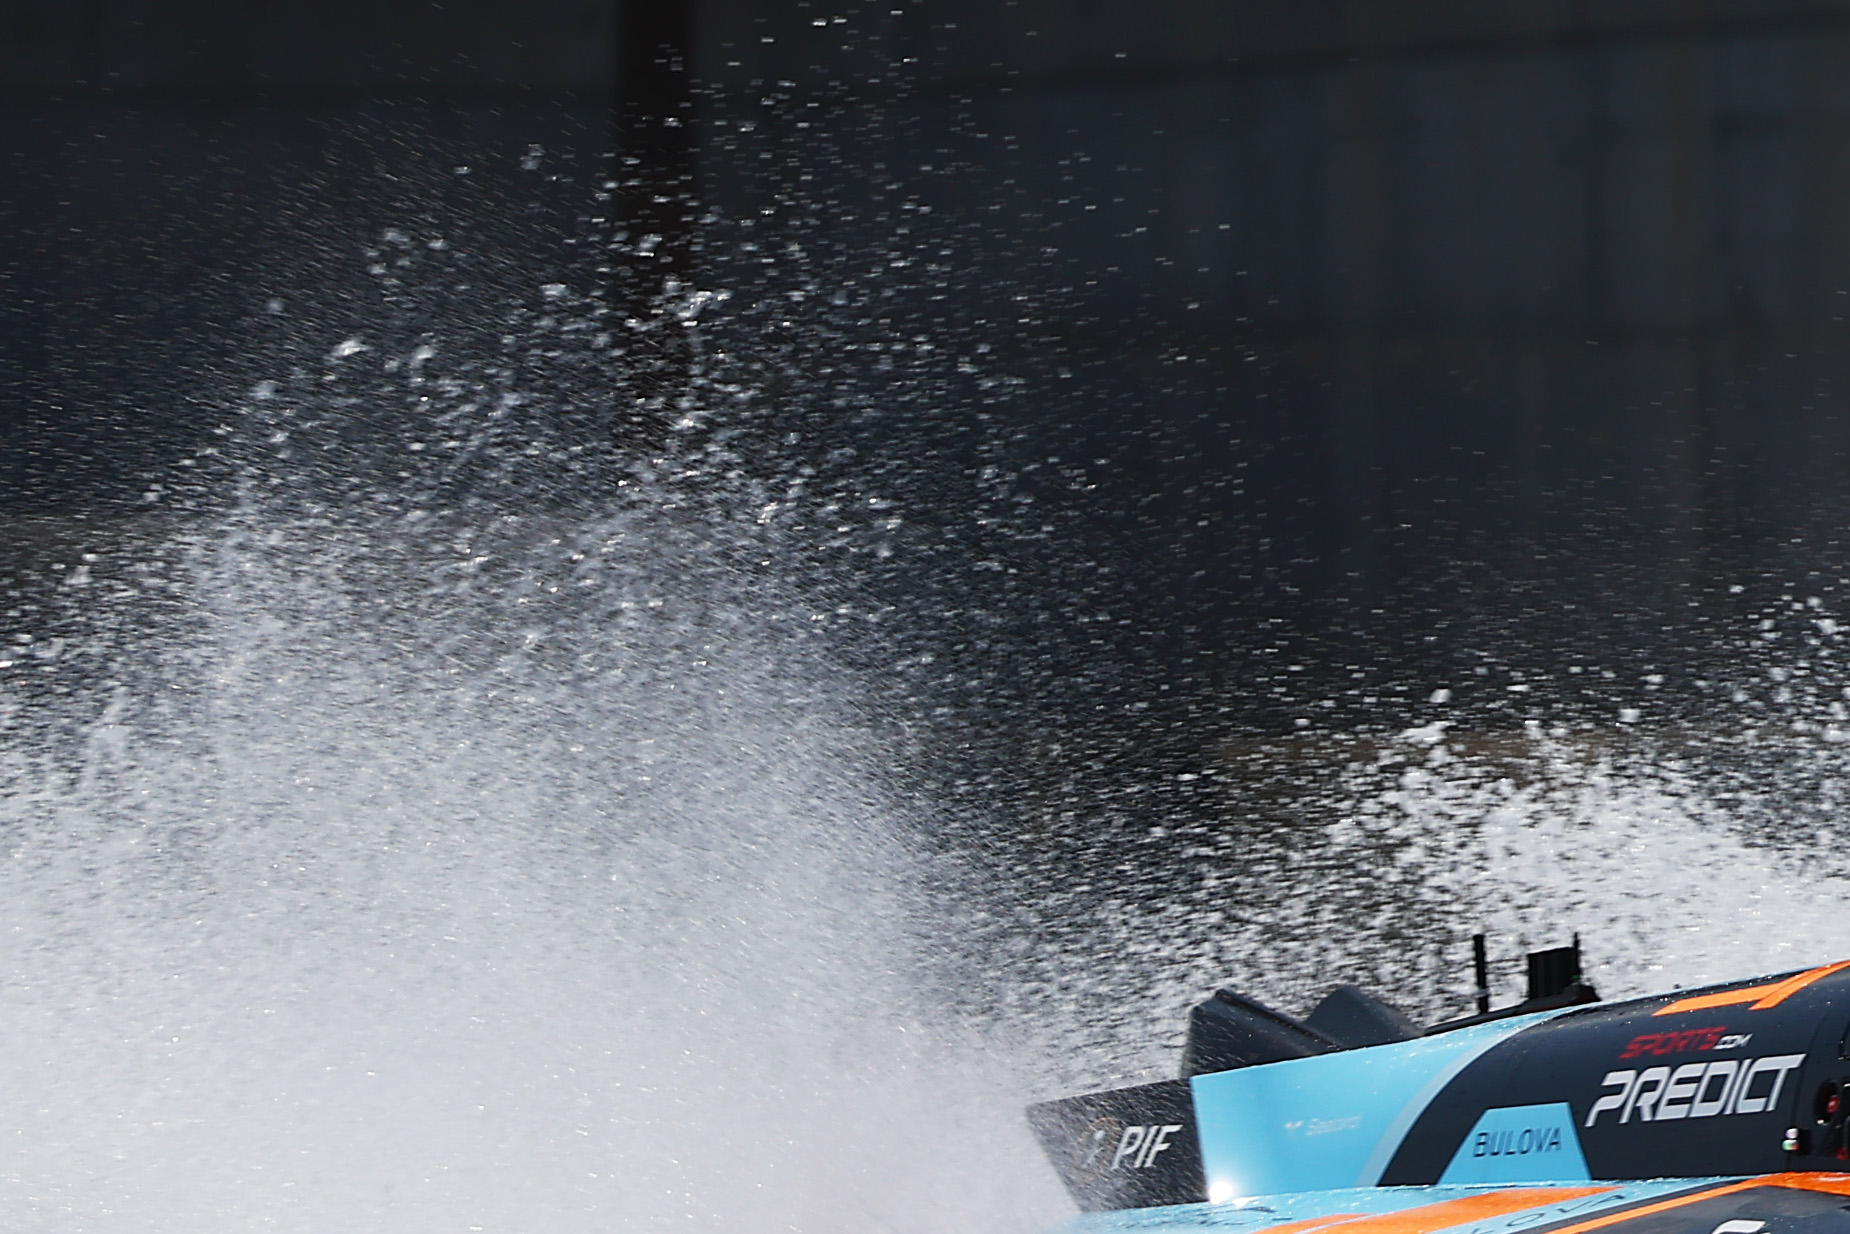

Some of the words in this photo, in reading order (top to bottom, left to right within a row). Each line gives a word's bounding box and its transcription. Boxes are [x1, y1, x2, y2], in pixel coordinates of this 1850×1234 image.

[1585, 1053, 1807, 1127] PREDICT
[1110, 1124, 1183, 1170] PIF
[1473, 1127, 1562, 1157] BULOVA
